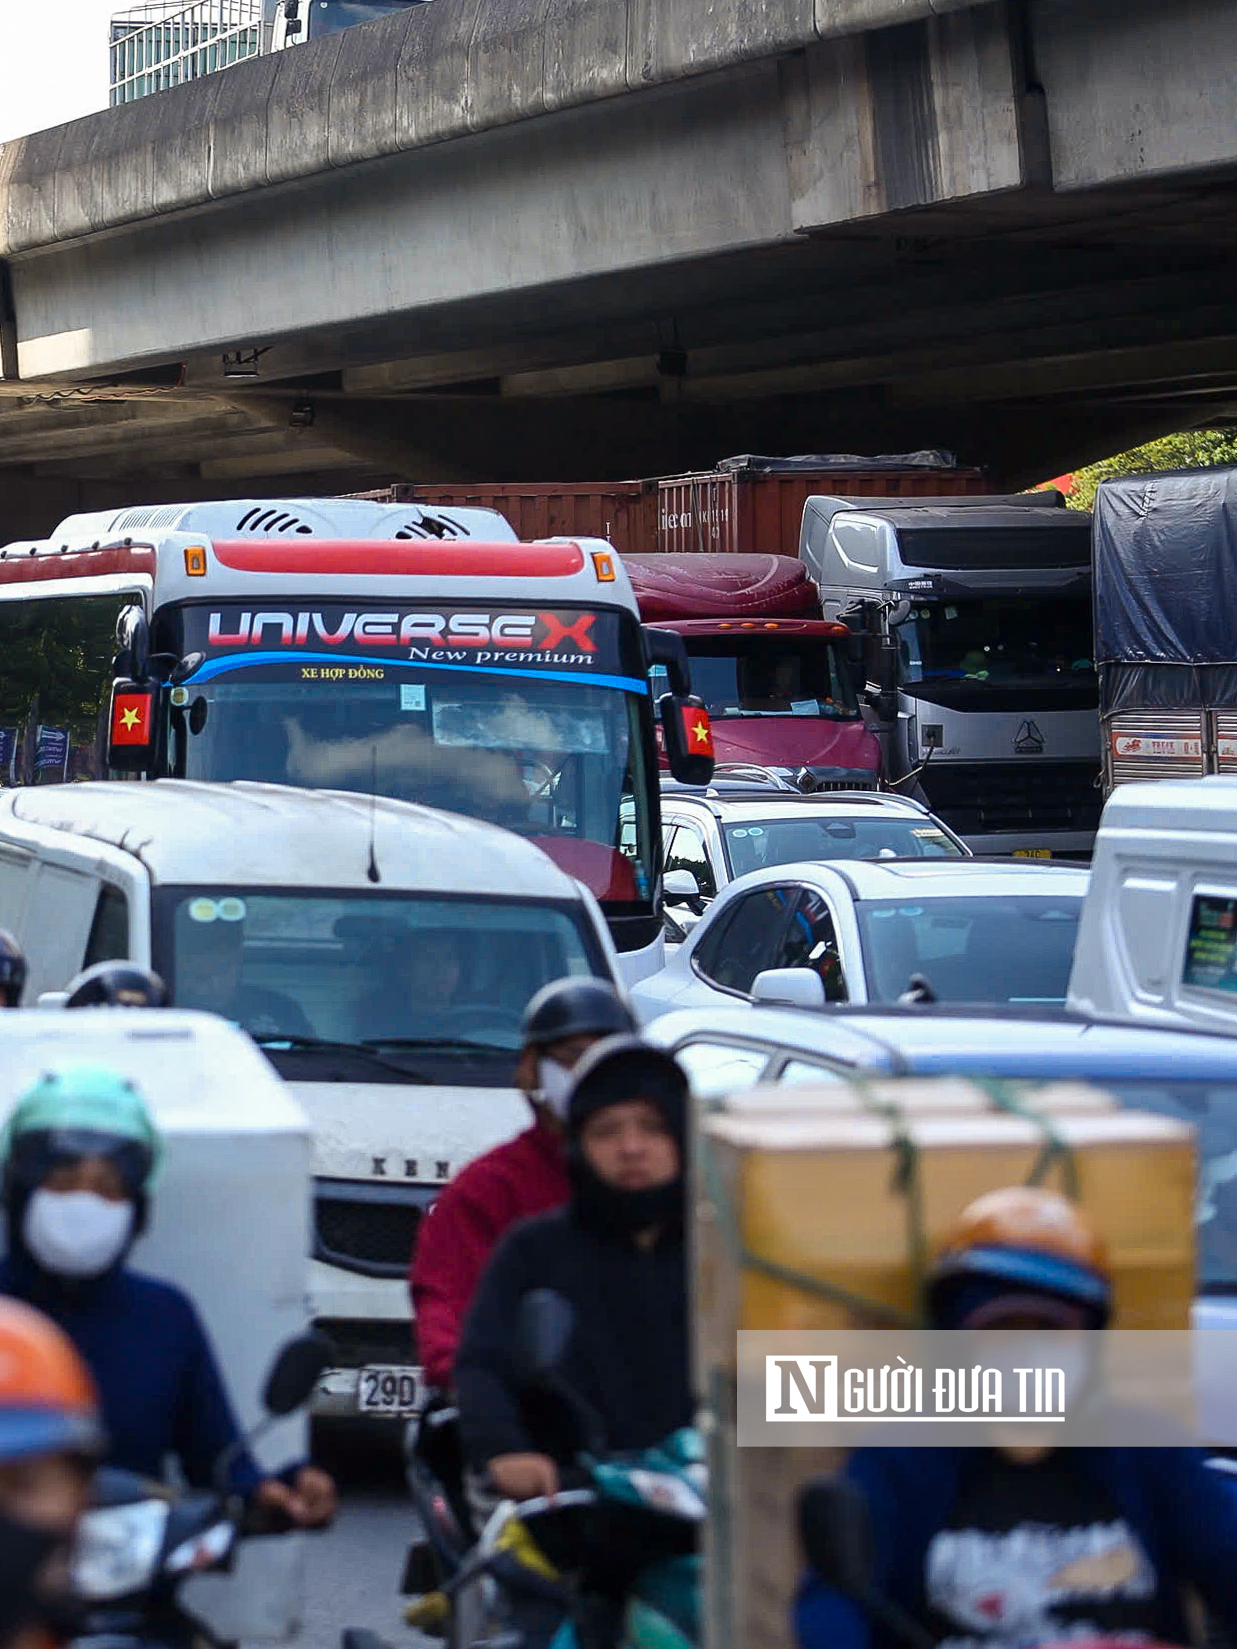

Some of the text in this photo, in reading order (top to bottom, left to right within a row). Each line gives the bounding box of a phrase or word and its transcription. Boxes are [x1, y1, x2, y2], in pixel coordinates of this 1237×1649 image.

[409, 647, 594, 665] New premium
[302, 665, 385, 681] XE HỢP ĐỒNG
[365, 1374, 415, 1406] 29D
